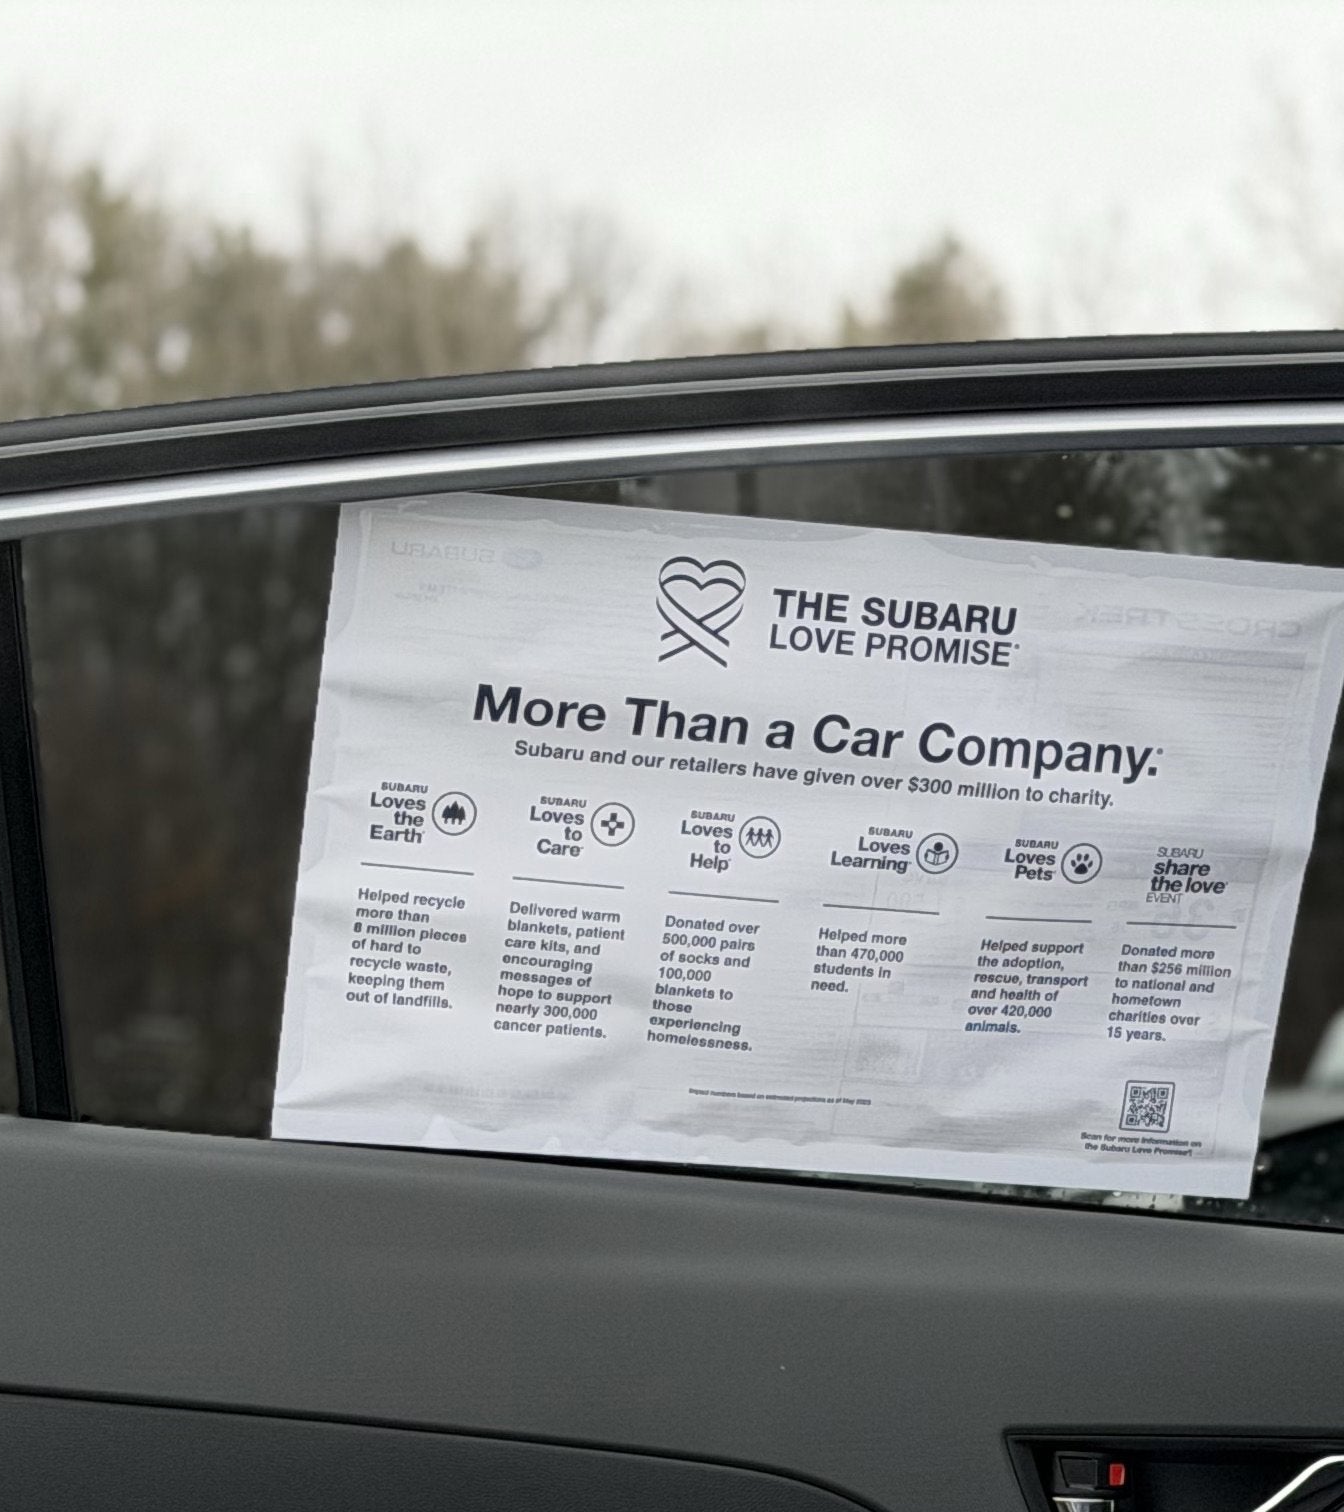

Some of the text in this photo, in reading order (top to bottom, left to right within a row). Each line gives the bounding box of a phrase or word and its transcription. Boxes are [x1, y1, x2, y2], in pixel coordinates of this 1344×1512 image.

[772, 587, 849, 623] THE
[860, 596, 1017, 635] SUBARU
[769, 623, 856, 655] LOVE
[472, 683, 606, 732] More
[624, 696, 748, 745] Than
[764, 719, 795, 750] a
[812, 713, 904, 758] Car
[514, 739, 1113, 810] Subaru and our retailers have given over $300 million to charity.
[380, 781, 428, 794] SUBARU
[370, 791, 426, 811] Loves
[539, 795, 587, 808] SUBARU
[393, 810, 424, 827] the
[529, 804, 584, 825] Loves
[690, 809, 735, 822] SUBARU
[563, 825, 582, 841] to
[680, 819, 733, 839] Loves
[867, 826, 913, 839] SUBARU
[713, 839, 731, 854] to
[857, 835, 910, 855] Loves
[1014, 838, 1059, 849] SUBARU
[1156, 846, 1204, 859] SUBARU
[1003, 847, 1056, 865] Loves
[1152, 858, 1210, 878] share
[1150, 874, 1182, 892] the
[357, 887, 465, 910] Helped recycle
[1145, 891, 1182, 903] EVENT
[355, 907, 429, 923] more than
[509, 900, 620, 923] Delivered warm
[353, 921, 466, 943] 8 million pieces
[507, 918, 625, 940] blankets, patient
[664, 914, 760, 934] Donated over
[661, 932, 755, 952] 500,000 pairs
[818, 926, 907, 945] Helped more
[351, 938, 421, 954] of hard to
[504, 937, 600, 955] care kits, and
[815, 944, 904, 963] than 470,000
[980, 938, 1084, 955] Helped support
[1120, 943, 1215, 959] Donated more
[349, 956, 451, 976] recycle waste,
[501, 954, 592, 974] encouraging
[659, 949, 750, 968] of socks and
[977, 955, 1064, 971] the adoption,
[658, 966, 711, 981] 100,000
[813, 962, 891, 978] students in
[1117, 960, 1231, 978] than $256 million
[347, 971, 444, 991] keeping them
[499, 970, 592, 987] messages of
[810, 980, 848, 992] need.
[973, 973, 1088, 988] rescue, transport
[1114, 976, 1215, 993] to national and
[345, 990, 452, 1008] out of landfills.
[497, 983, 612, 1005] hope to support
[654, 982, 733, 1000] blankets to
[970, 987, 1059, 1001] and health of
[1111, 992, 1181, 1007] hometown
[495, 1003, 597, 1020] nearly 300,000
[652, 998, 692, 1013] those
[967, 1004, 1052, 1018] over 420,000
[649, 1015, 741, 1036] experiencing
[964, 1020, 1021, 1033] animals.
[1108, 1009, 1200, 1026] charities over
[493, 1019, 606, 1038] cancer patients.
[1107, 1025, 1166, 1042] 15 years.
[646, 1029, 752, 1051] homelessness.
[1081, 1131, 1102, 1140] Scan
[1103, 1133, 1116, 1141] for
